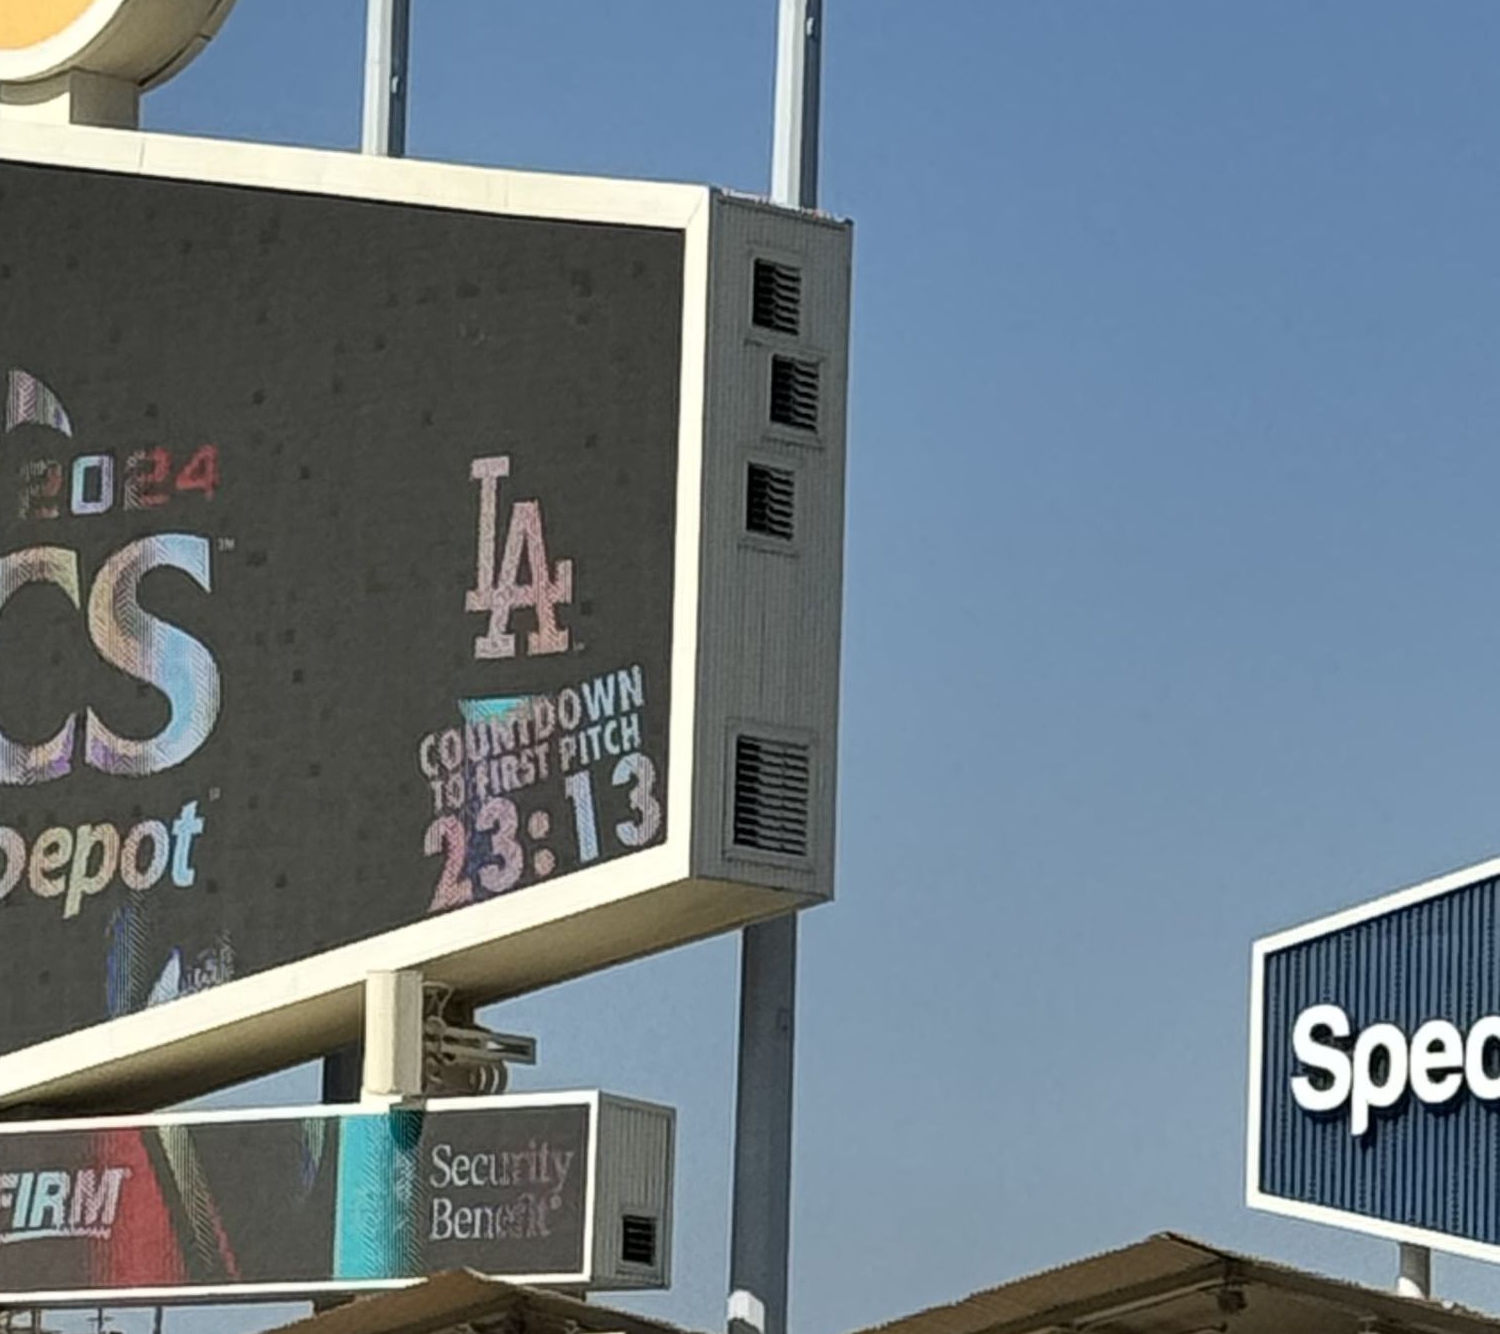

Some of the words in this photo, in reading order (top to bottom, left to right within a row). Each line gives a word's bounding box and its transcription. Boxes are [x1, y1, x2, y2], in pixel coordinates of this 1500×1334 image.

[17, 444, 221, 519] 2024
[419, 665, 644, 778] COUNTDOWN
[431, 769, 465, 815] TO
[474, 742, 550, 801] FIRST
[559, 713, 641, 771] PITCH
[424, 752, 661, 913] 23:13
[429, 1140, 573, 1193] Security
[429, 1192, 553, 1242] Benefit
